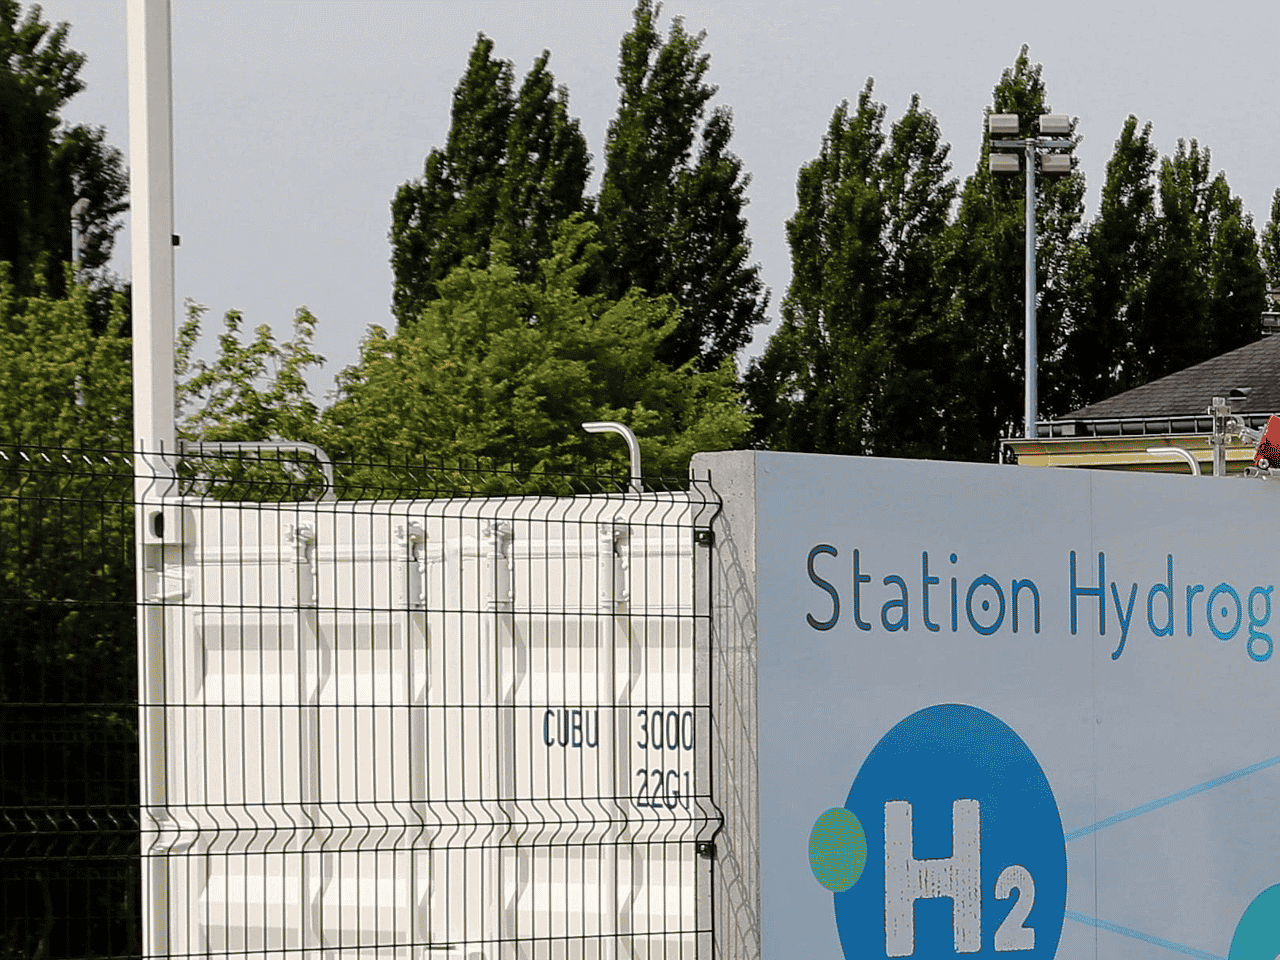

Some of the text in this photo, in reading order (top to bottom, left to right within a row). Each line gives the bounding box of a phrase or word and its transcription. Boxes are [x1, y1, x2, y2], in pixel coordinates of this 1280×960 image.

[806, 544, 1040, 636] Station
[543, 709, 693, 751] CUBU 3000
[636, 769, 691, 810] 22G1
